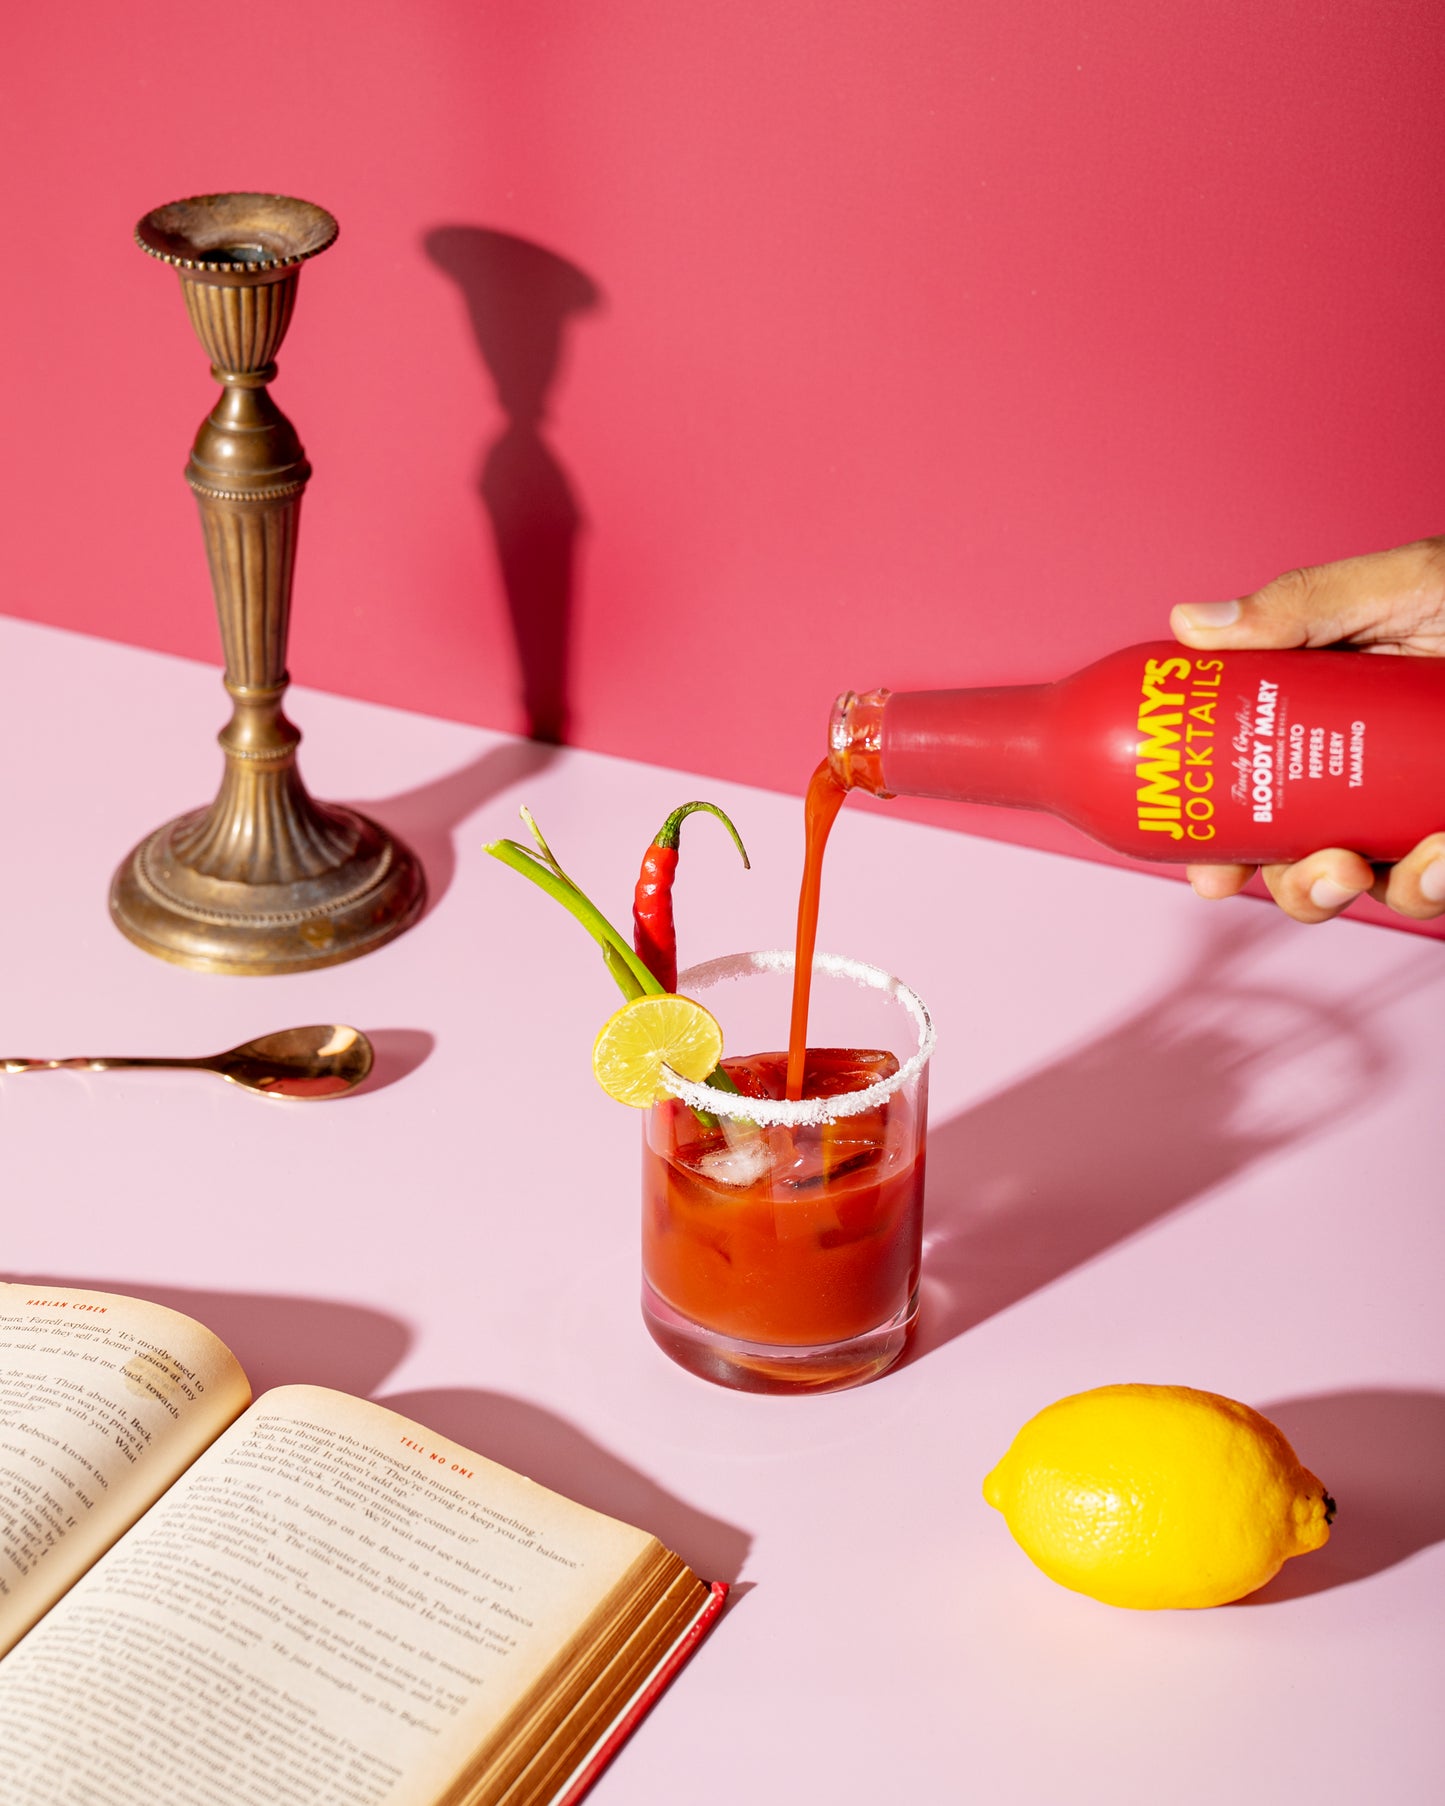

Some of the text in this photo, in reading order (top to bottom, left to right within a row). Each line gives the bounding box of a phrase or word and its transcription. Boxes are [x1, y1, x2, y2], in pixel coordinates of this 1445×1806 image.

[1136, 657, 1191, 841] JIMMY'S
[1184, 659, 1224, 841] COCKTAILS
[1252, 679, 1279, 823] BLOODY MARY
[1289, 723, 1305, 780] TOMATO
[1308, 727, 1326, 779] PEPPERS
[1328, 731, 1345, 776] CELERY
[1348, 720, 1366, 788] TAMARIND
[25, 1300, 107, 1314] HARLAN COBEN
[29, 1316, 63, 1327] Farrell
[137, 1339, 172, 1361] mostly
[173, 1360, 196, 1381] used
[195, 1380, 205, 1393] to
[40, 1347, 61, 1355] and
[62, 1349, 80, 1359] she
[81, 1353, 99, 1363] led
[100, 1360, 117, 1369] me
[119, 1366, 142, 1384] back
[146, 1383, 180, 1419] towards
[51, 1328, 71, 1339] they
[74, 1333, 93, 1341] sell
[102, 1337, 131, 1352] home
[134, 1349, 169, 1374] version
[170, 1373, 181, 1384] at
[181, 1383, 197, 1401] any
[8, 1369, 24, 1378] she
[86, 1391, 117, 1410] about
[13, 1380, 34, 1390] they
[36, 1384, 61, 1396] have
[61, 1393, 76, 1401] no
[77, 1398, 98, 1412] way
[98, 1409, 110, 1420] to
[109, 1418, 137, 1444] prove
[2, 1389, 30, 1399] mind
[28, 1395, 62, 1409] games
[65, 1405, 88, 1421] with
[115, 1435, 137, 1464] What
[18, 1423, 60, 1447] Rebecca
[62, 1443, 93, 1471] knows
[400, 1436, 475, 1479] TELL NO ONE
[2, 1442, 95, 1510] work my voice and
[256, 1422, 293, 1434] Shauna
[294, 1429, 336, 1449] thought
[336, 1444, 368, 1464] about
[424, 1489, 457, 1511] trying
[456, 1505, 469, 1517] to
[470, 1511, 496, 1530] keep
[494, 1526, 516, 1541] you
[517, 1537, 537, 1549] off
[265, 1443, 286, 1454] how
[288, 1449, 312, 1465] long
[313, 1459, 340, 1475] until
[339, 1469, 357, 1483] the
[357, 1479, 381, 1497] next
[380, 1492, 423, 1519] message
[423, 1516, 456, 1537] comes
[278, 1457, 295, 1469] the
[280, 1436, 298, 1447] but
[323, 1450, 333, 1460] It
[371, 1474, 394, 1490] add
[338, 1433, 360, 1447] who
[361, 1443, 412, 1472] witnessed
[411, 1468, 428, 1482] the
[428, 1479, 467, 1502] murder
[467, 1499, 481, 1510] or
[13, 1484, 35, 1505] Why
[35, 1504, 66, 1538] choose
[65, 1515, 79, 1528] If
[259, 1463, 276, 1475] sat
[276, 1469, 301, 1484] back
[302, 1479, 315, 1490] in
[315, 1484, 334, 1498] her
[391, 1524, 414, 1541] wait
[414, 1538, 437, 1553] and
[436, 1549, 454, 1562] see
[454, 1559, 482, 1576] what
[481, 1570, 491, 1581] it
[3, 1545, 30, 1577] which
